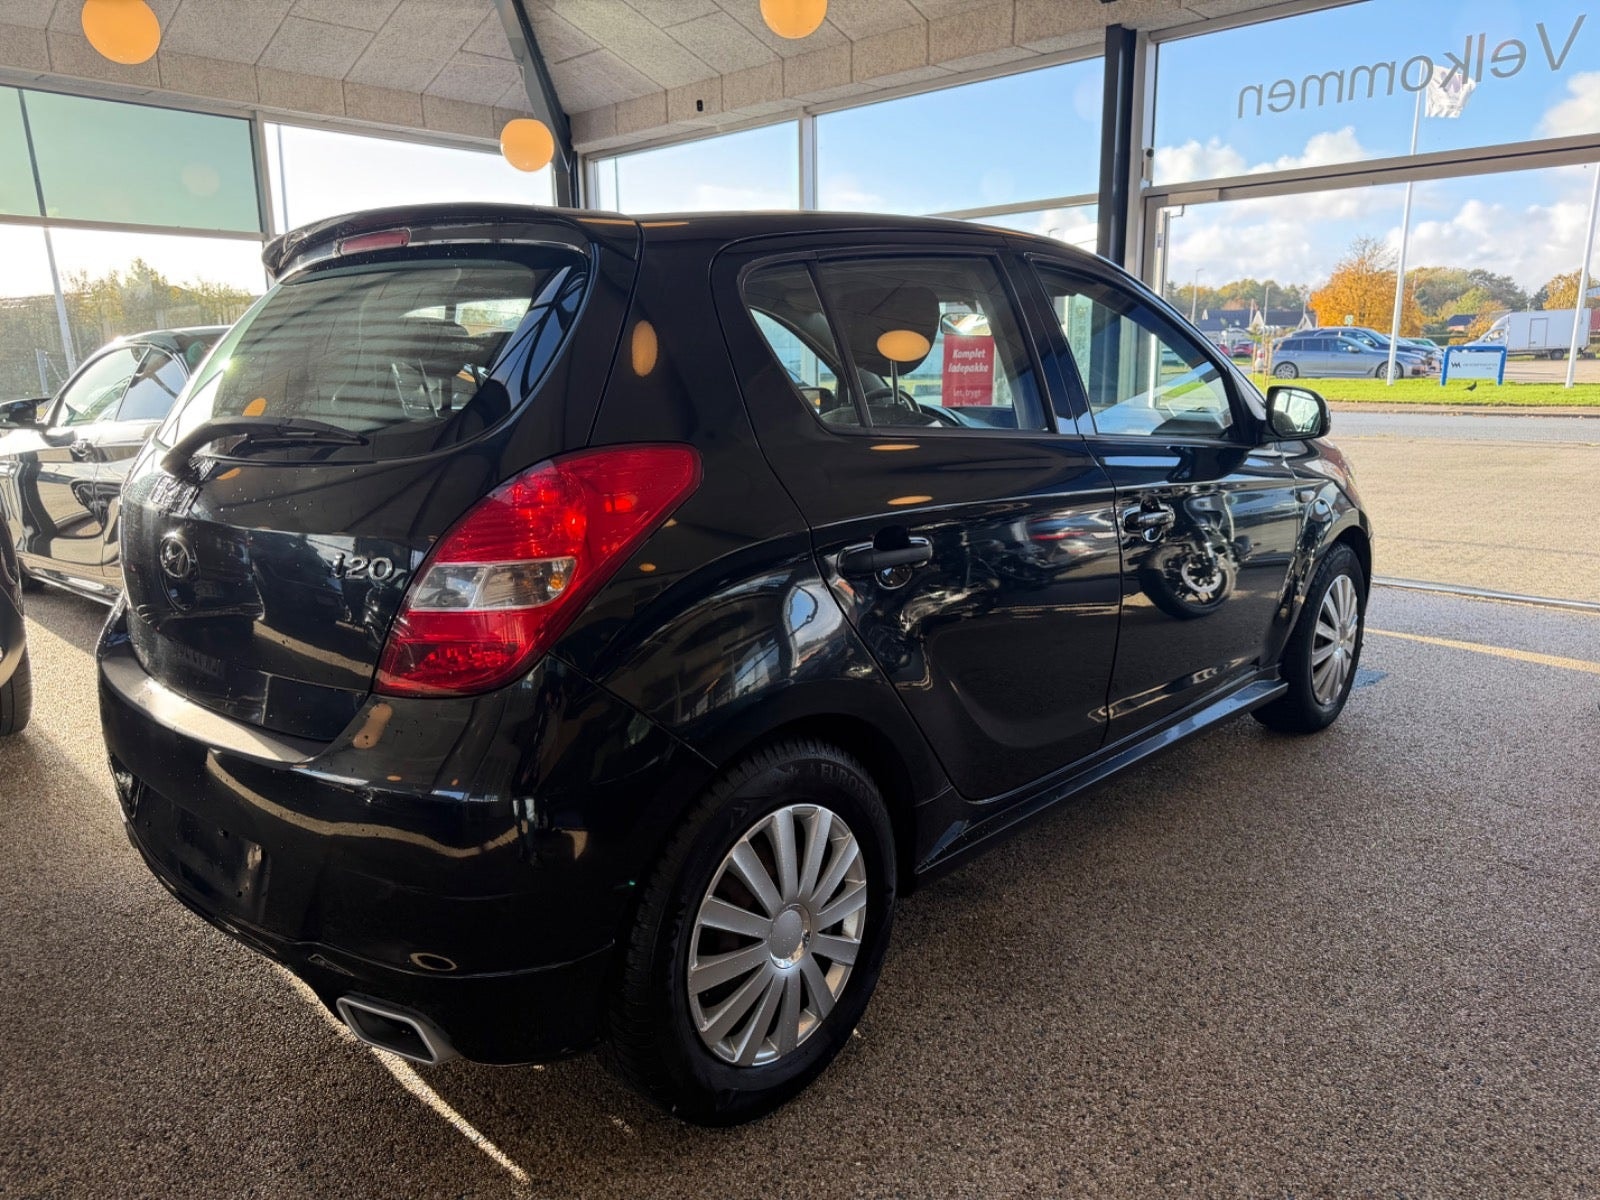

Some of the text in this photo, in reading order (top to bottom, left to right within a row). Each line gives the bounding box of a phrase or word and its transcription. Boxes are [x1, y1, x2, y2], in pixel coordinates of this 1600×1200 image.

[952, 348, 986, 360] Komplet
[948, 362, 989, 375] ladepakke
[331, 552, 394, 579] i20
